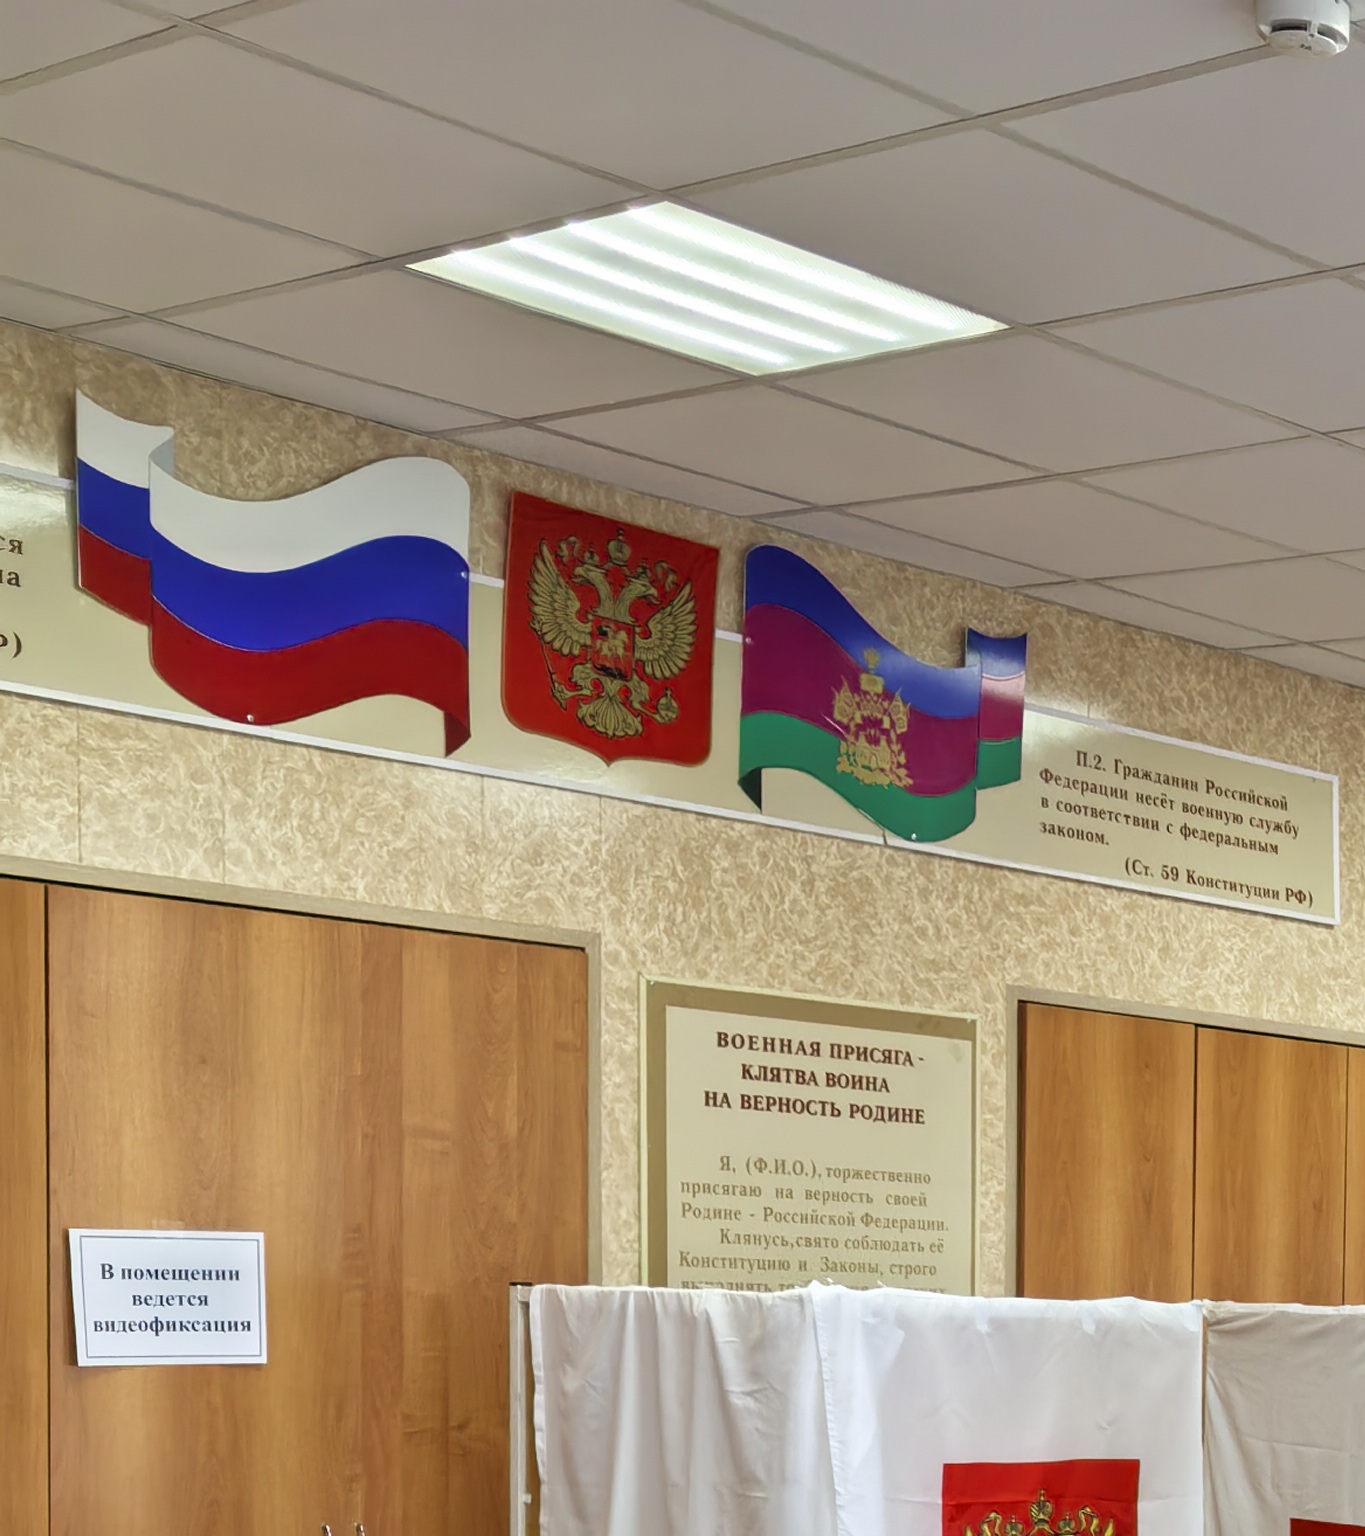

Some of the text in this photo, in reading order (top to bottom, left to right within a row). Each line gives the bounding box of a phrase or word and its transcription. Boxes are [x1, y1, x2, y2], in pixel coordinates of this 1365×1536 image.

[1076, 750, 1288, 812] П.2. Гражданин Российской
[1039, 767, 1299, 839] Федерации несёт военную службу
[1039, 821, 1110, 846] законом.
[1041, 797, 1279, 855] в соответствии с федеральным
[1124, 856, 1313, 909] (Ст. 59 Конституции РФ)
[716, 1031, 821, 1057] ВОЕННАЯ
[829, 1044, 914, 1067] ПРИСЯГА
[740, 1063, 890, 1093] КЛЯТВА ВОИНА
[703, 1090, 925, 1125] НА ВЕРНОСТЬ РОДИНЕ
[719, 1155, 736, 1175] Я,
[825, 1166, 931, 1185] торжественно
[680, 1181, 928, 1208] присягаю на верность своей
[680, 1202, 742, 1223] Родине
[762, 1206, 855, 1228] Российской
[860, 1211, 949, 1235] Федерации.
[844, 1236, 925, 1254] соблюдать
[929, 1239, 944, 1254] её
[100, 1262, 240, 1282] В помещении
[679, 1251, 937, 1279] Конституцию и Законы, строго
[131, 1292, 209, 1308] ведется
[93, 1316, 251, 1336] видеофиксация
